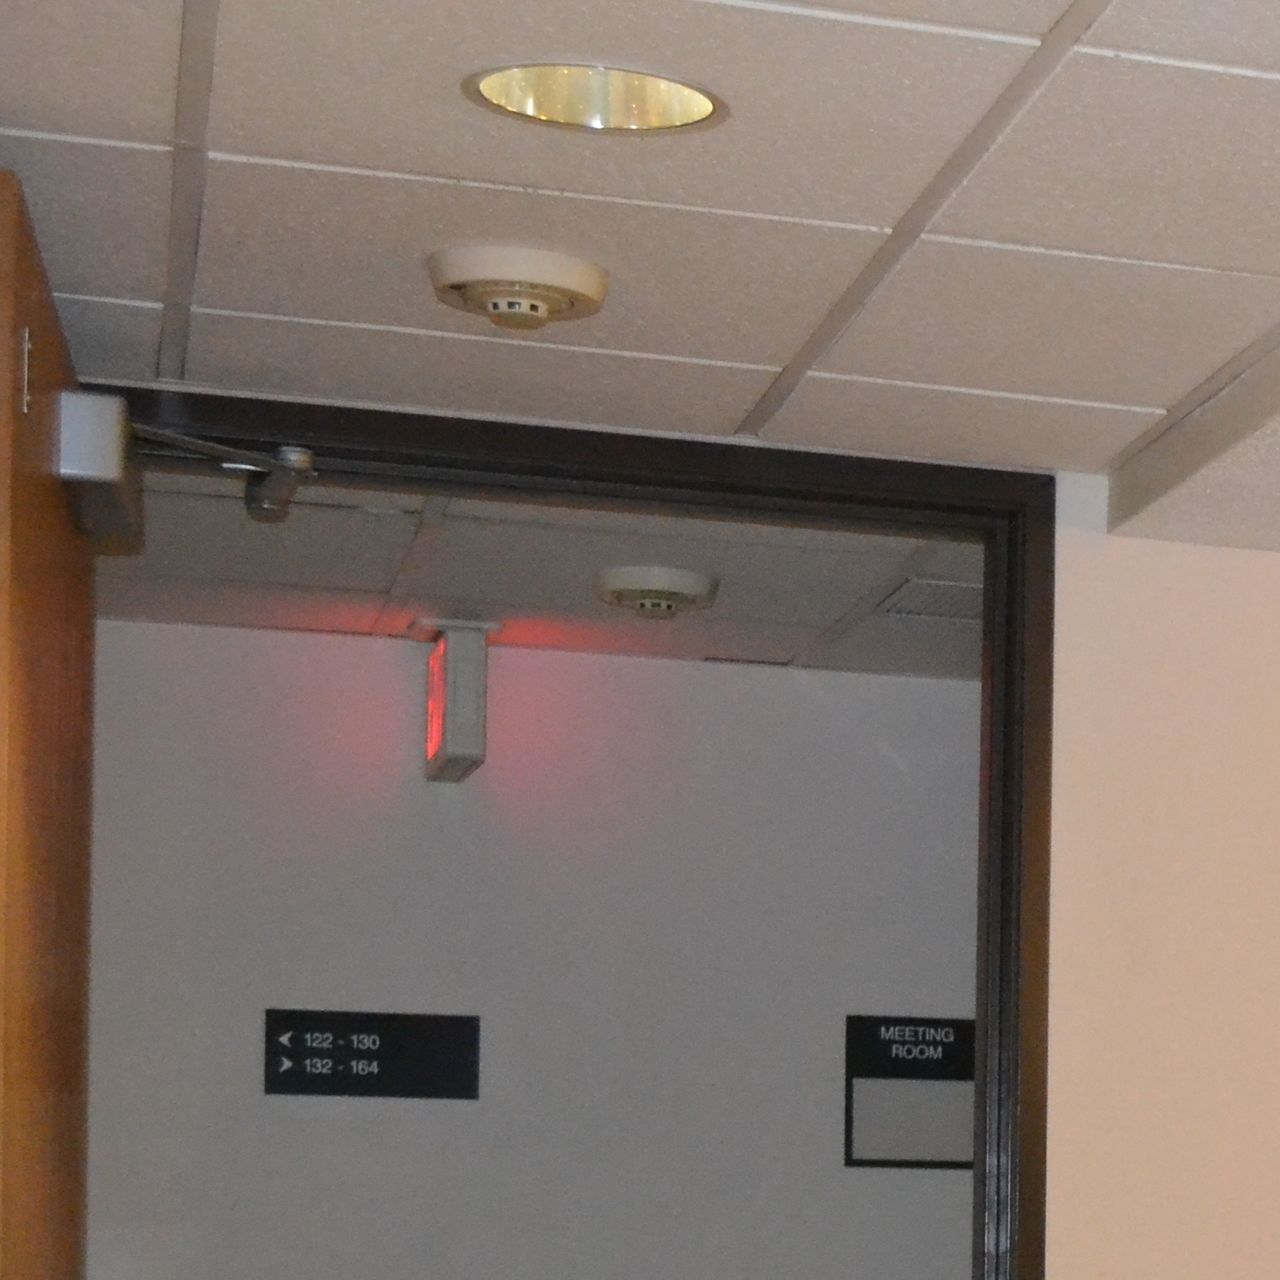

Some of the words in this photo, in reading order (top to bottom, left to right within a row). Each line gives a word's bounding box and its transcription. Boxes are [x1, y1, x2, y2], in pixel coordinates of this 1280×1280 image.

[304, 1031, 334, 1049] 122
[351, 1033, 380, 1050] 130
[880, 1025, 955, 1042] MEETING
[891, 1043, 943, 1060] ROOM
[304, 1058, 334, 1075] 132
[351, 1060, 379, 1076] 164
